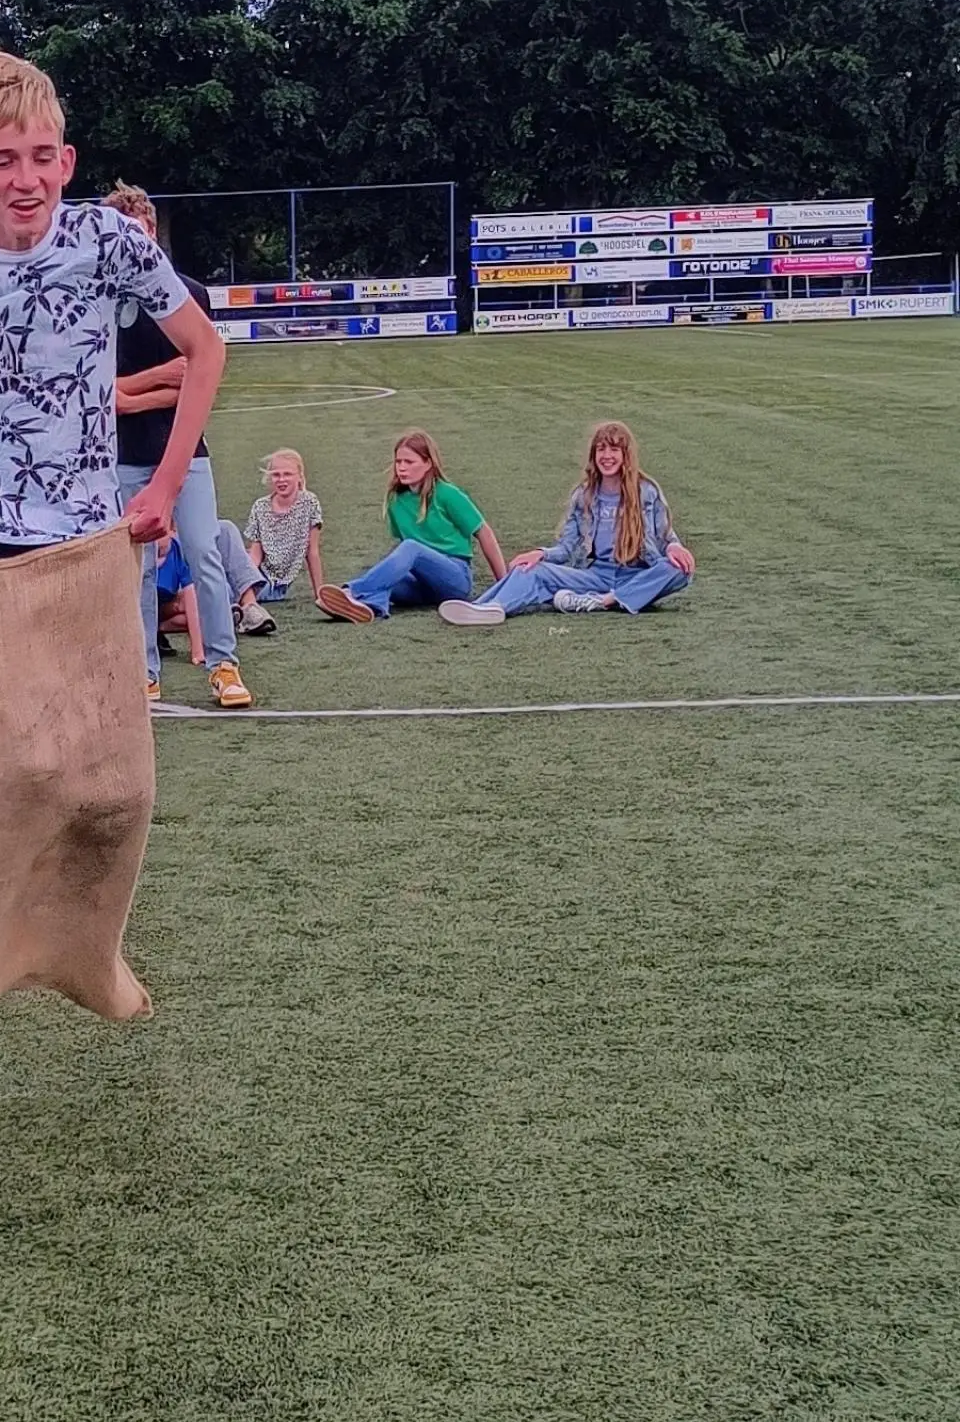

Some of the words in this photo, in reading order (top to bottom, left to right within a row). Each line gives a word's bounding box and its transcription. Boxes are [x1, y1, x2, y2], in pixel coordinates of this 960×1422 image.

[603, 239, 647, 251] HOOGSPEL
[858, 298, 885, 310] SMK
[900, 296, 947, 309] RUPERT
[492, 314, 517, 323] TER
[521, 312, 559, 322] HORST
